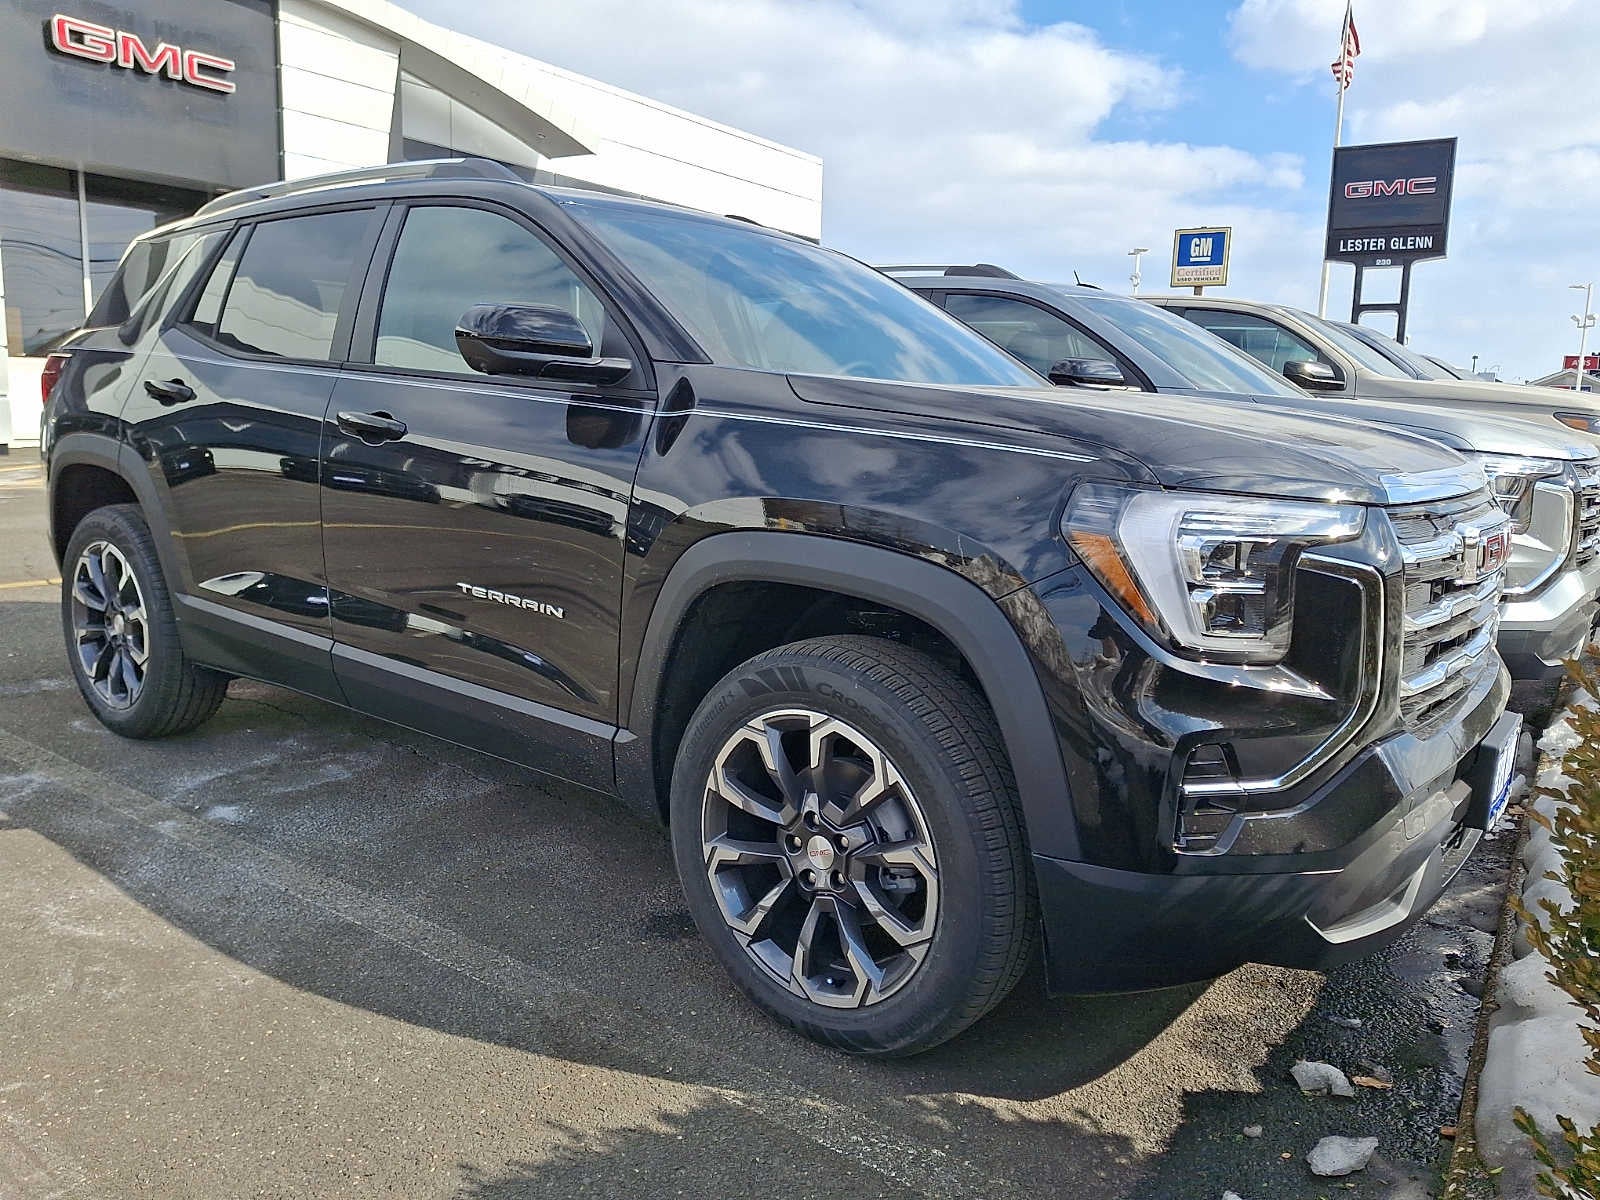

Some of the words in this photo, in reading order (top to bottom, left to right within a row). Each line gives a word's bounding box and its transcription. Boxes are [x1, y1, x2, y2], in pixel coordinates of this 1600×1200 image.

[52, 14, 236, 93] GMC
[1344, 177, 1437, 199] GMC
[1190, 237, 1213, 257] GM
[1339, 238, 1386, 252] LESTER
[1390, 236, 1433, 250] GLENN
[1177, 267, 1221, 277] Certified
[1571, 359, 1592, 367] AS
[456, 582, 564, 619] TERRAIN
[809, 849, 832, 857] GMC
